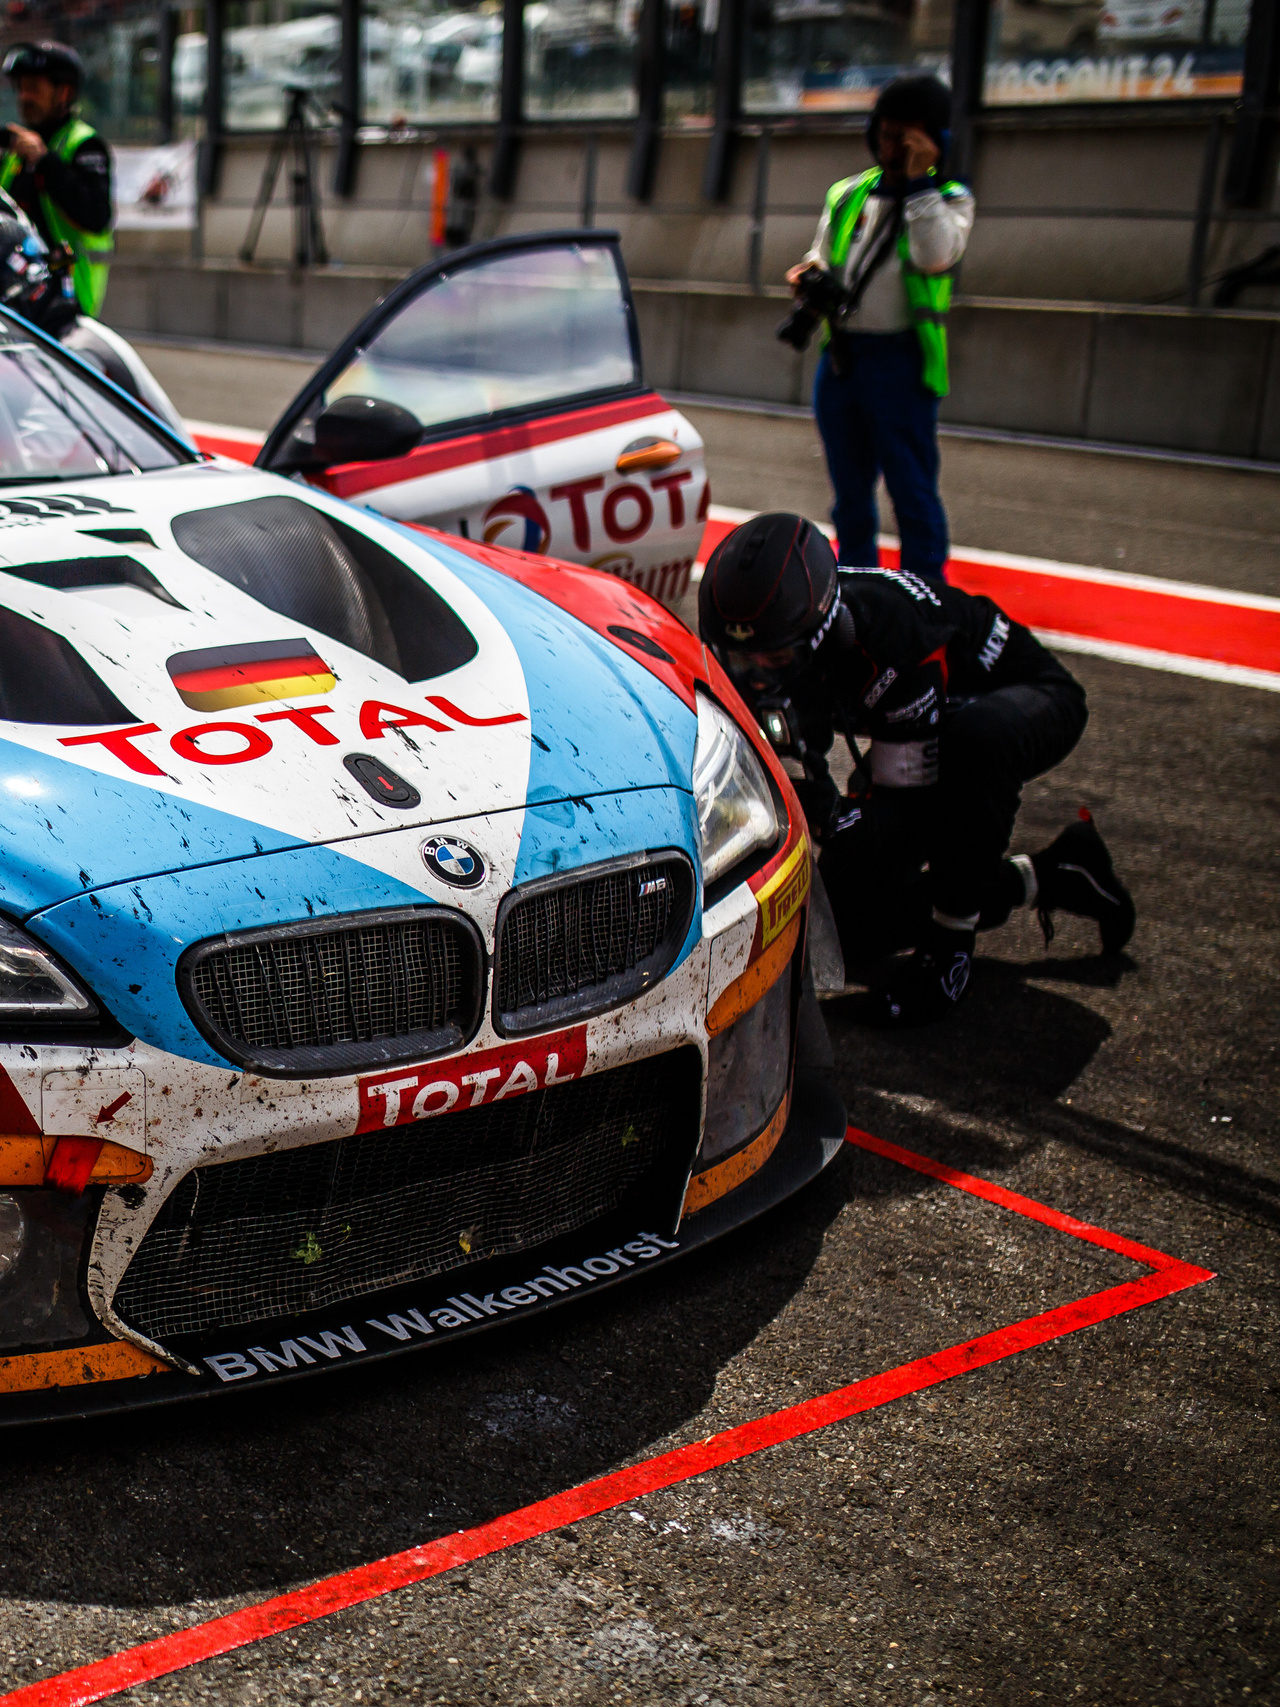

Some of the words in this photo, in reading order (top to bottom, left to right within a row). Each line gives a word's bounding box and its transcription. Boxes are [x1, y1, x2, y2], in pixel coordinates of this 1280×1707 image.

[57, 696, 528, 776] TOTAL
[367, 1052, 575, 1127] TOTAL
[202, 1325, 367, 1382] BMW
[366, 1231, 680, 1340] Walkenhorst
